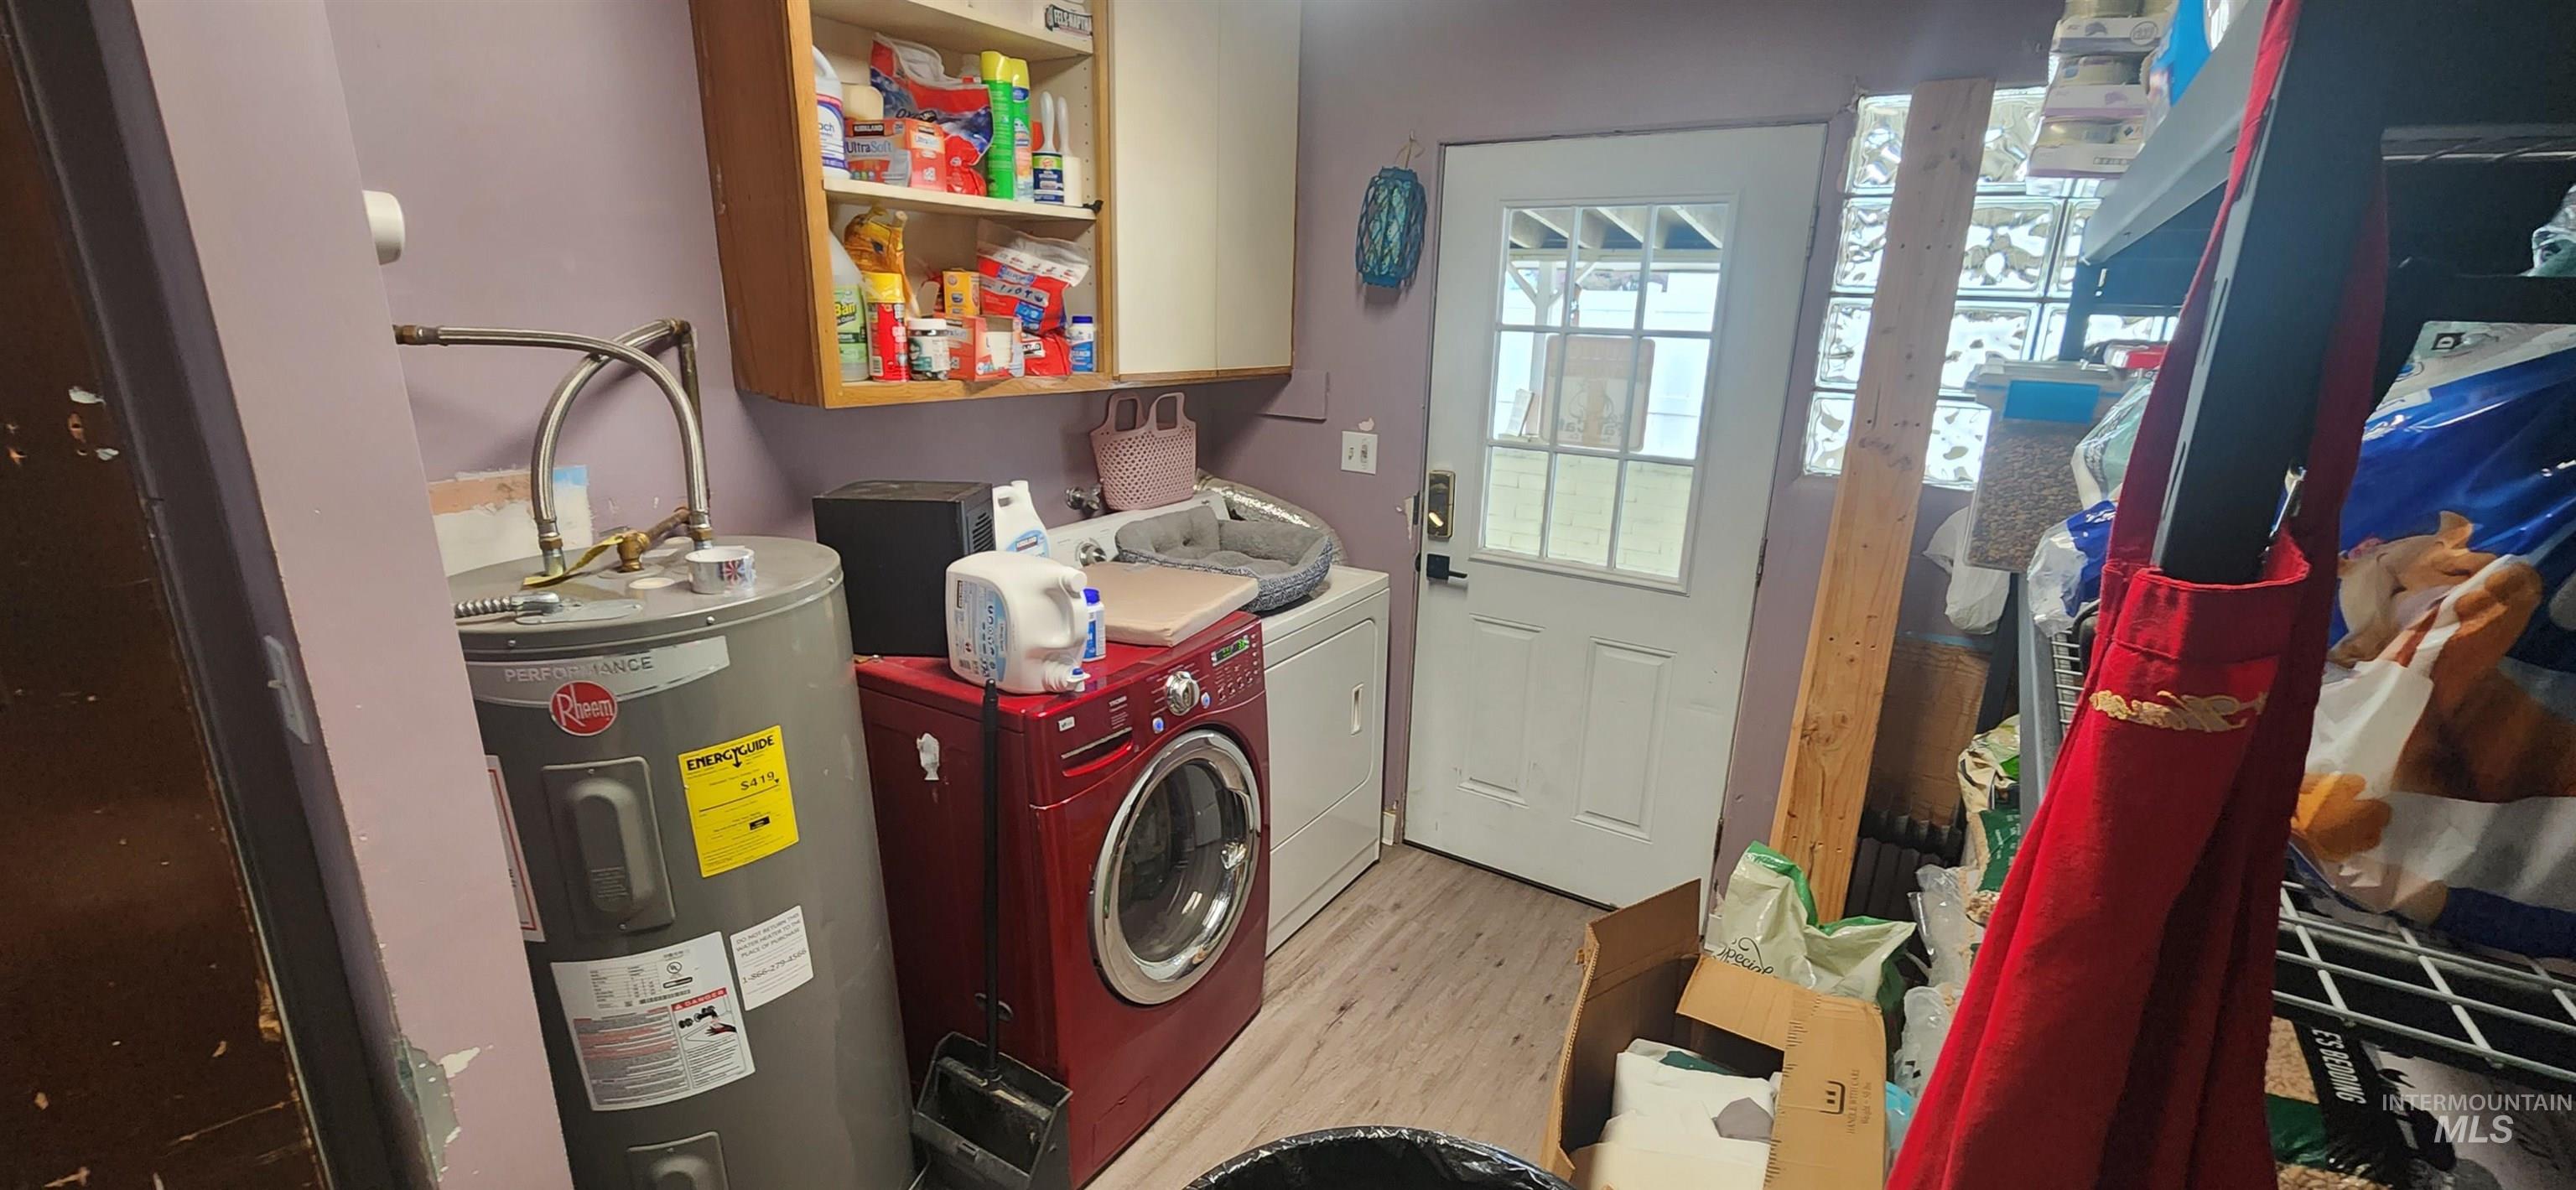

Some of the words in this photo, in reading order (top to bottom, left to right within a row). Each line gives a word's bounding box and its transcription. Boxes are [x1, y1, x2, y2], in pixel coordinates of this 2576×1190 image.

[818, 122, 834, 133] ach
[846, 140, 892, 153] UltraSoft
[505, 656, 653, 682] PERFORANCE
[556, 683, 614, 727] Rheem
[686, 735, 775, 772] ENERGYGUIDE
[684, 989, 726, 1006] DANGER
[2319, 1048, 2367, 1104] BEDDING
